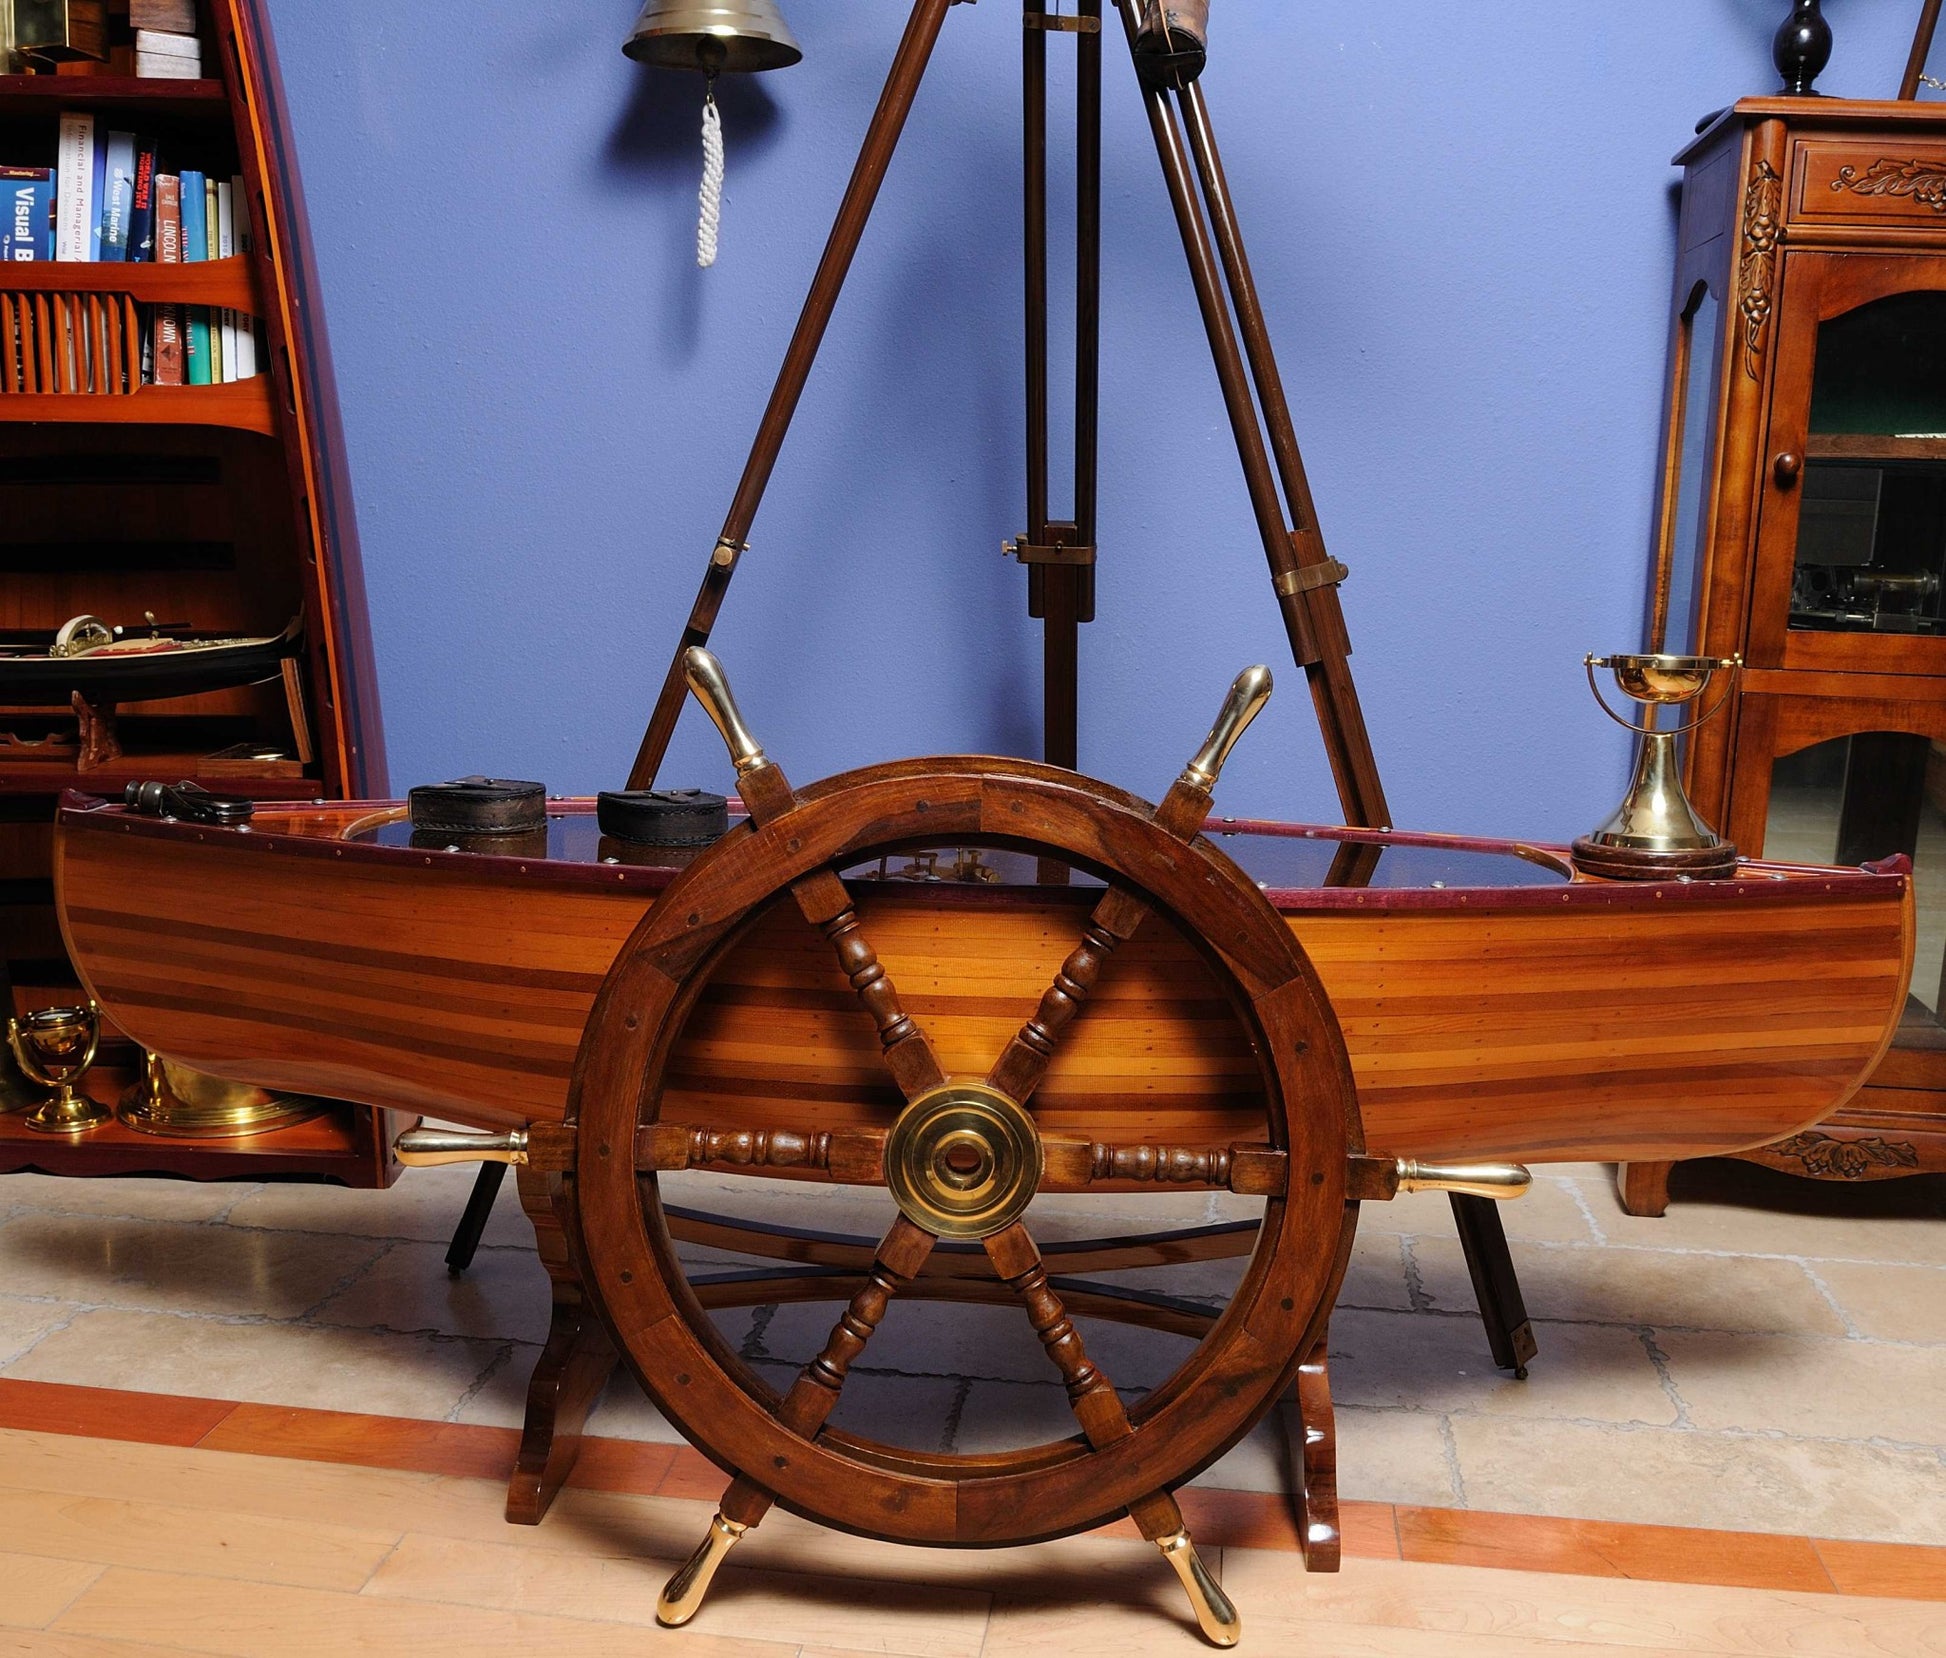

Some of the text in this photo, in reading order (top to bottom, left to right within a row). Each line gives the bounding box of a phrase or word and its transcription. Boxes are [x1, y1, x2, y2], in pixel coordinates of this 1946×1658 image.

[77, 124, 87, 171] Financial
[143, 152, 152, 182] WORLD
[76, 175, 84, 193] and
[141, 182, 150, 200] WAR
[15, 187, 35, 242] Visual
[72, 198, 84, 253] Managerial
[109, 180, 123, 243] West Marine
[163, 220, 177, 263] LINCOLN
[163, 304, 177, 343] KNOWN
